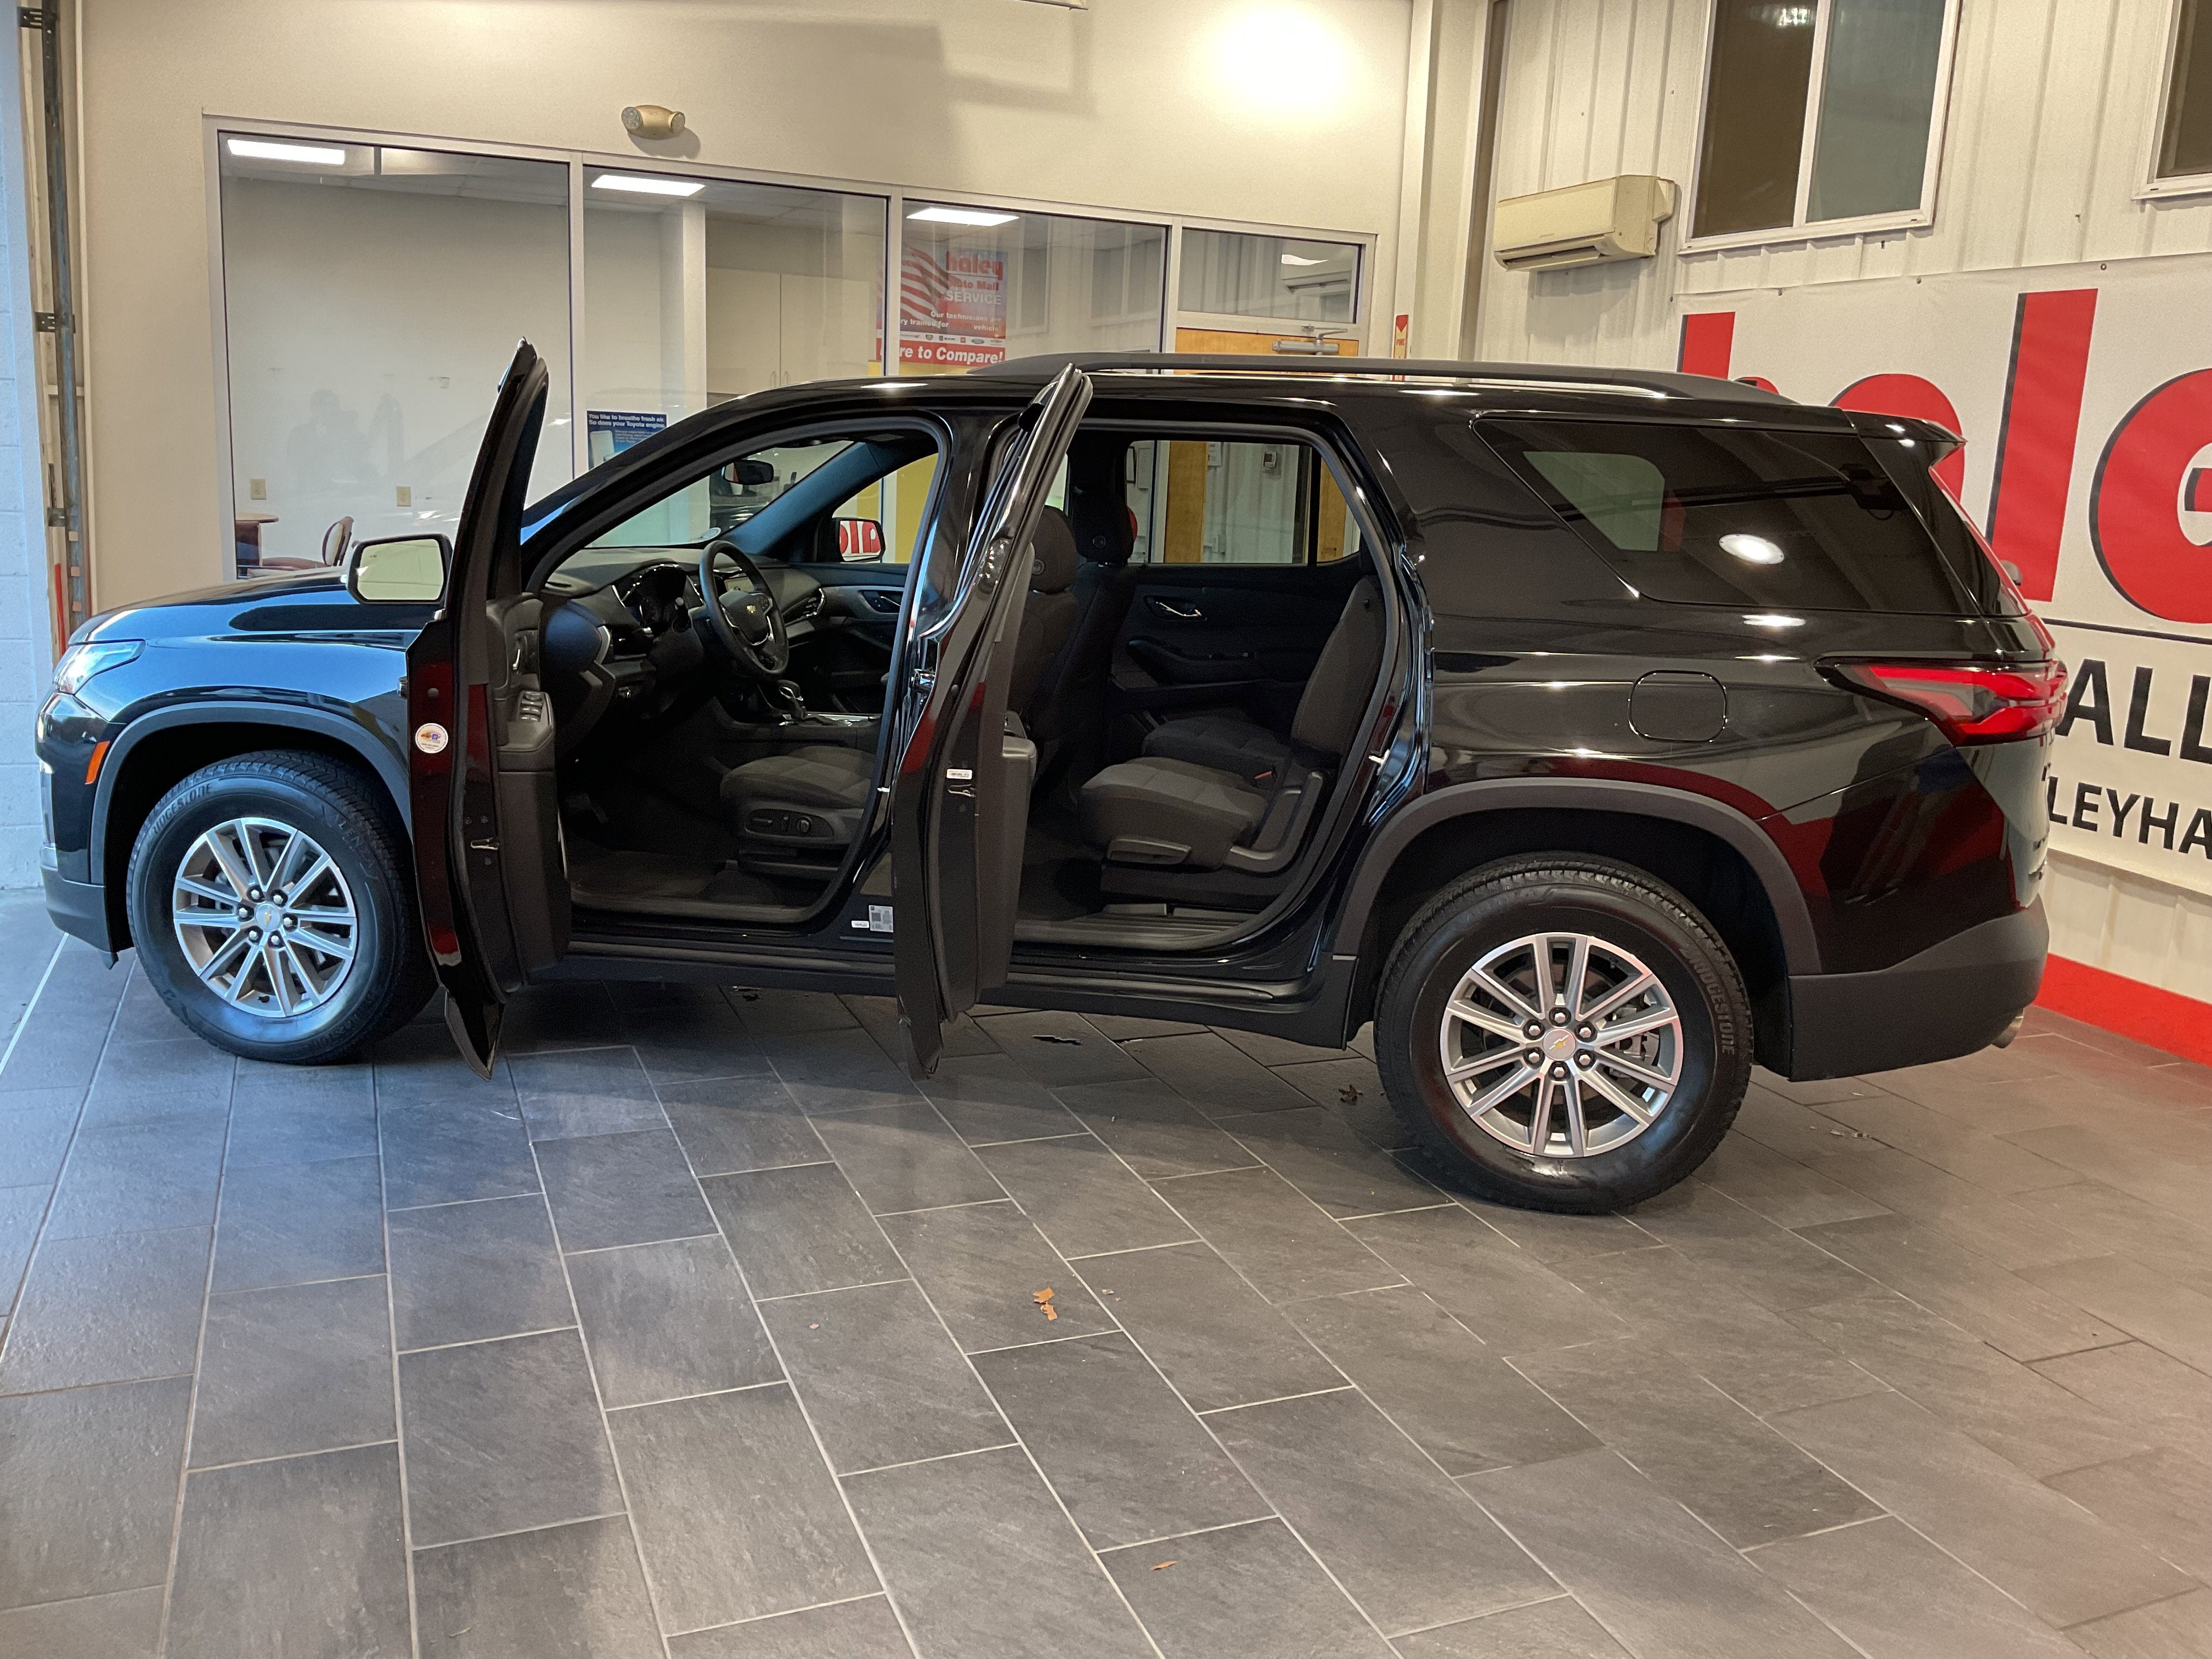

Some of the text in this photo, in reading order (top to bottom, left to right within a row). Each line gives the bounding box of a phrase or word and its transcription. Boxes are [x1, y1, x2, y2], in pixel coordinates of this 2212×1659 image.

[946, 251, 1003, 281] haley
[977, 280, 998, 291] Mall
[946, 290, 1001, 305] SERVICE
[910, 318, 936, 327] trained
[946, 312, 988, 321] technicians
[918, 346, 932, 359] to
[936, 347, 1003, 365] Compare!
[147, 783, 212, 846] RIDGESTONE
